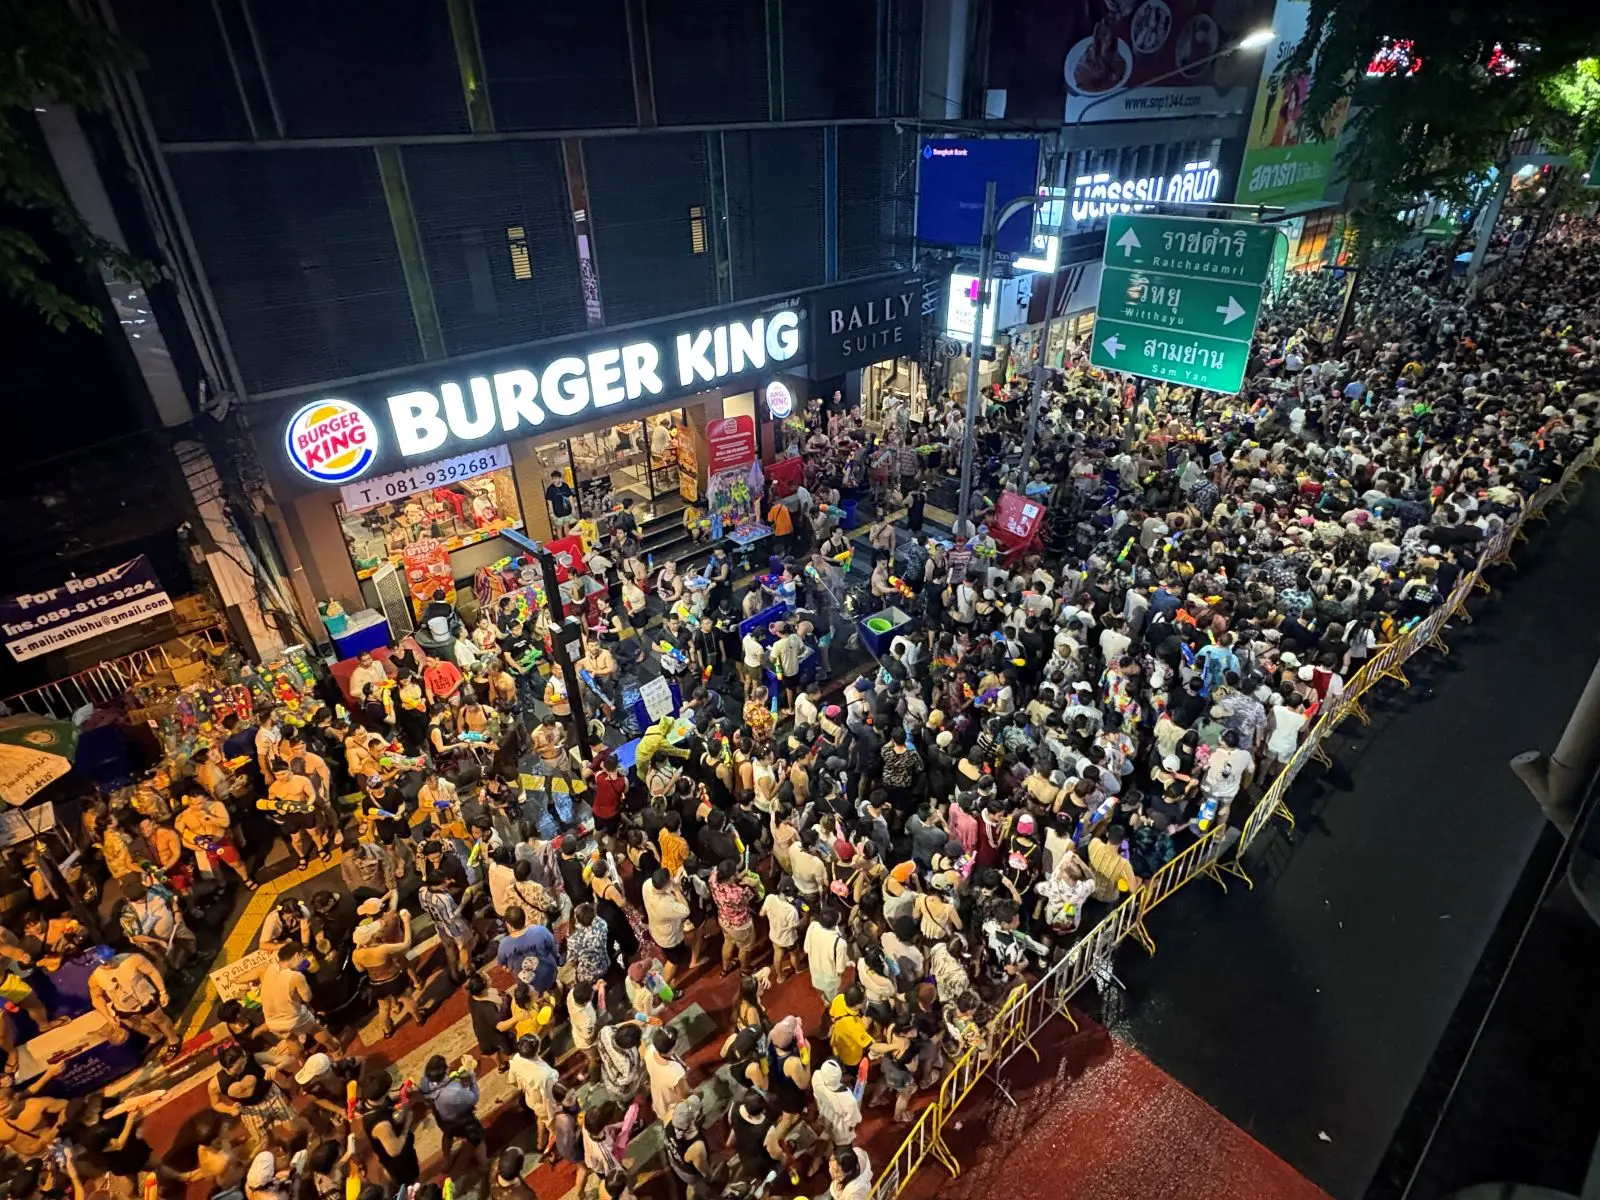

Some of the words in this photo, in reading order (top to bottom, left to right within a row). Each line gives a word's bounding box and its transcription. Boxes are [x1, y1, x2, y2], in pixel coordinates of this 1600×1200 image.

[932, 149, 953, 157] Bangkok
[955, 148, 968, 156] Bank
[1162, 228, 1247, 258] ราชดำริ
[1153, 256, 1245, 276] Ratchadamri
[1137, 276, 1181, 314] วิทยุ
[830, 292, 914, 335] BALLY
[1125, 307, 1184, 326] Witthayu
[842, 326, 903, 356] SUITE
[1143, 338, 1225, 370] สามย่าน
[387, 342, 663, 457] BURGER
[676, 311, 799, 387] KING
[1152, 364, 1177, 377] Sam
[1185, 371, 1207, 382] Yan
[297, 411, 361, 450] BURGER
[305, 424, 367, 470] KING
[360, 488, 380, 503] T.
[386, 454, 498, 495] 081-9392681
[16, 588, 59, 610] For
[65, 567, 121, 594] Rent
